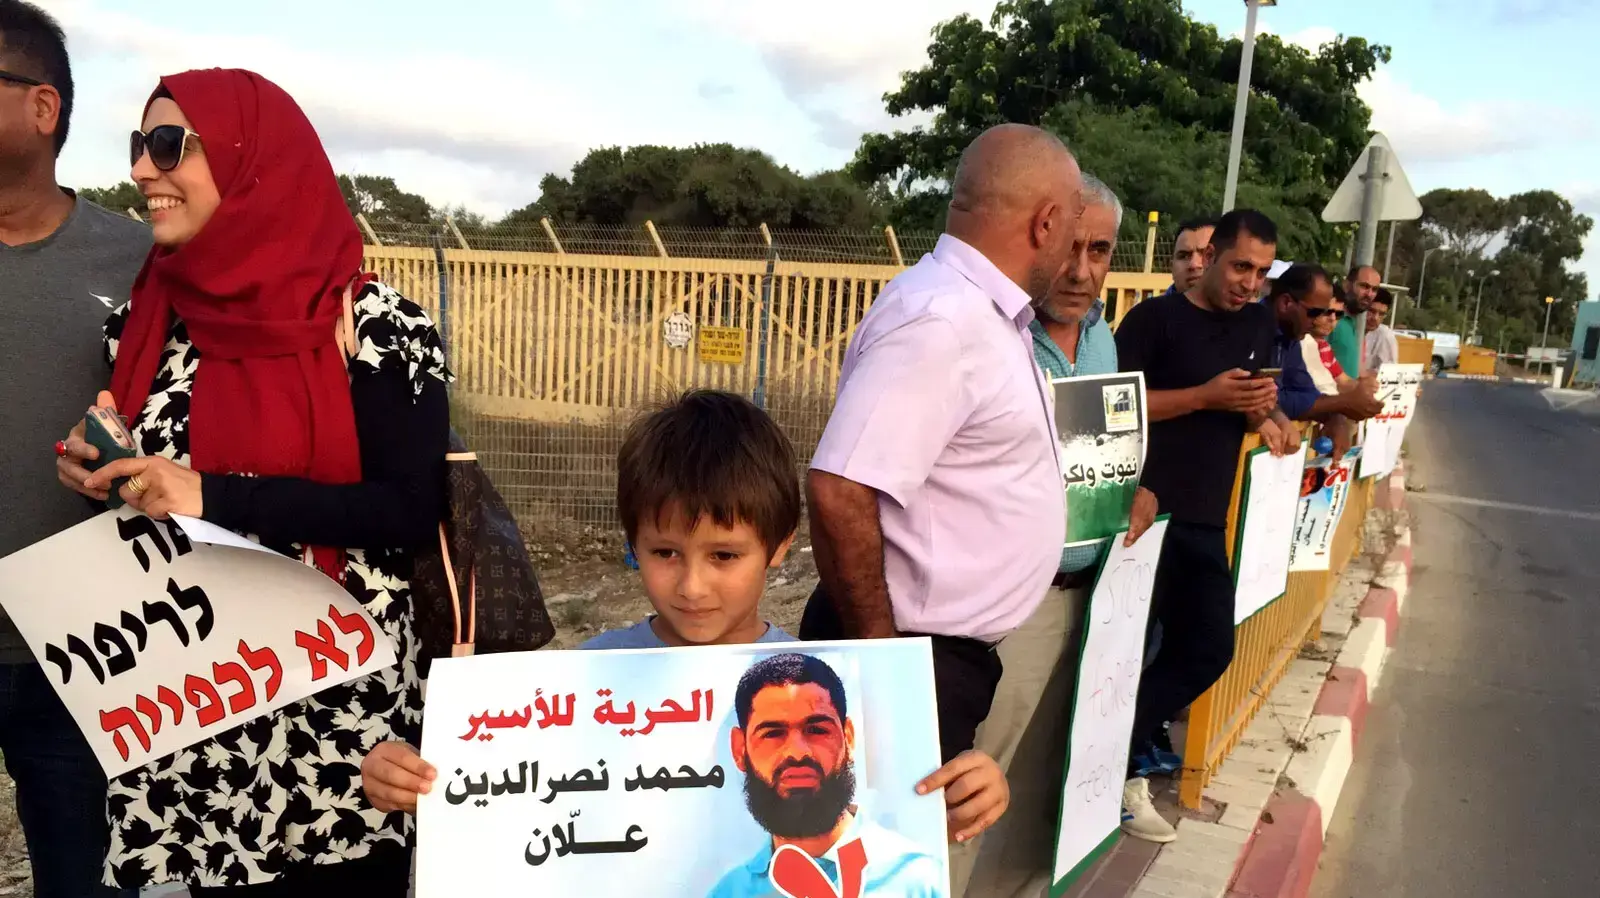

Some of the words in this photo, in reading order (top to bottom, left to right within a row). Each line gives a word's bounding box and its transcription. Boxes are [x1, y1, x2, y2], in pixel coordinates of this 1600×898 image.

[46, 577, 215, 685] לריפוי
[295, 604, 375, 682] לא
[99, 639, 283, 762] לכפייה
[458, 688, 577, 742] للأسير
[593, 687, 715, 737] الحرية
[624, 763, 726, 792] محمد
